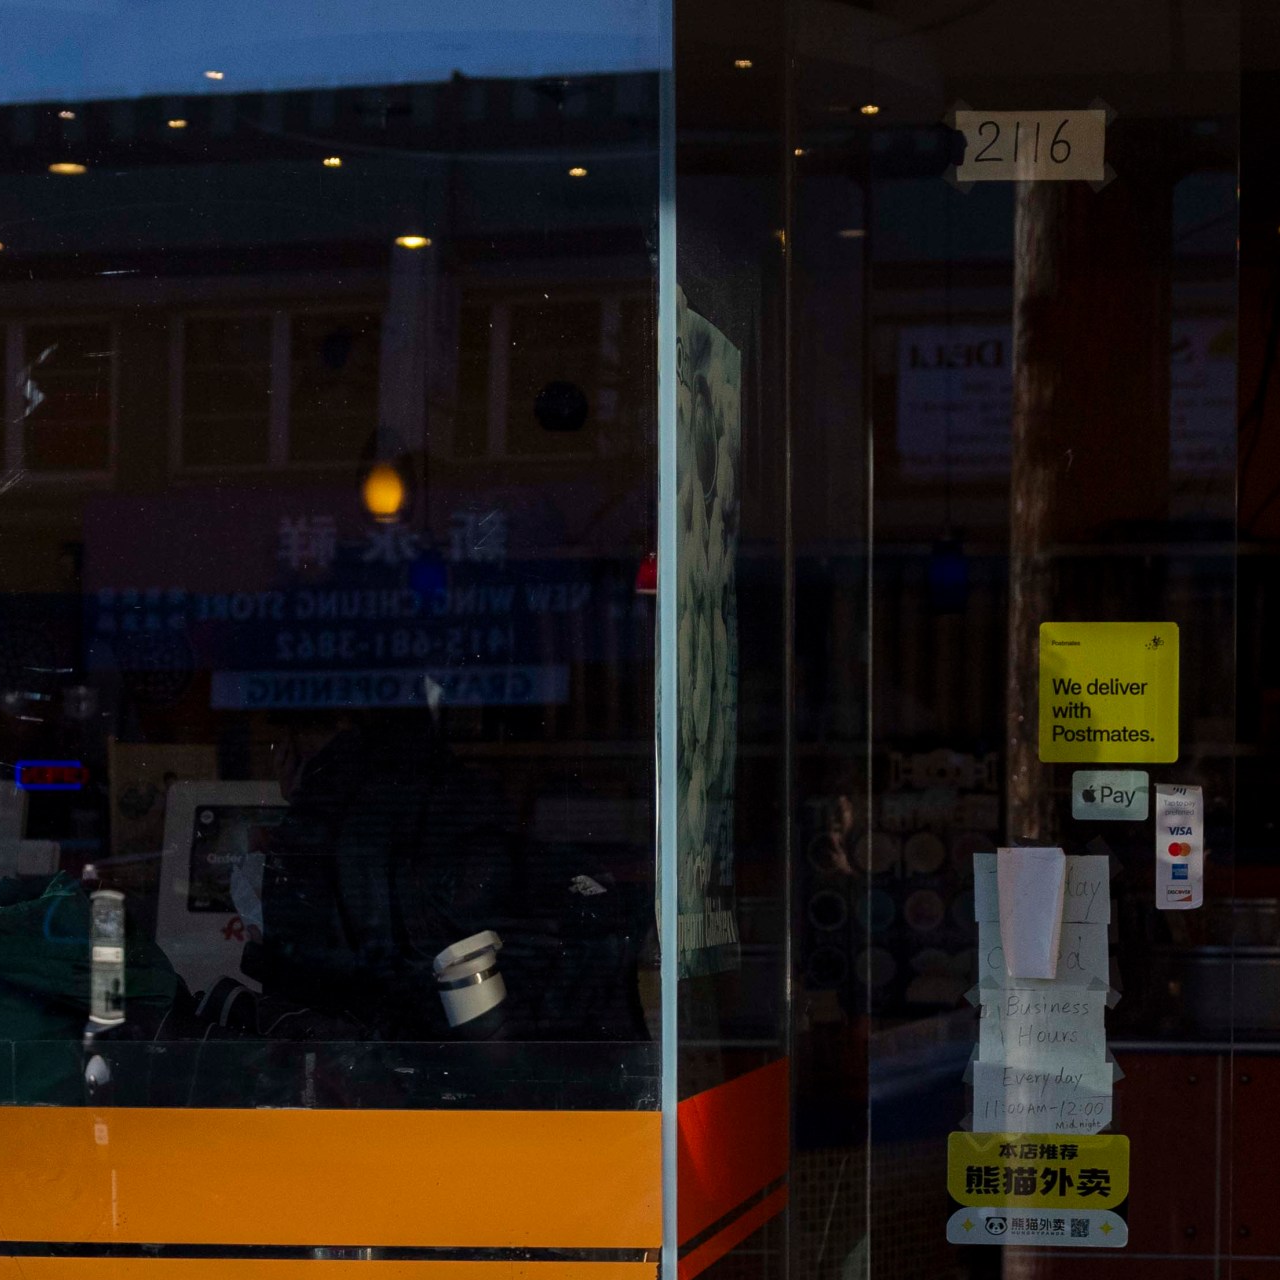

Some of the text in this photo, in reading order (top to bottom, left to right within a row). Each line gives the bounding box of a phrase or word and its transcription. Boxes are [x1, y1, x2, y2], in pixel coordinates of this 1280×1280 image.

[974, 119, 1072, 165] 2116
[1052, 677, 1148, 697] We deliver
[1052, 701, 1091, 719] with
[1052, 725, 1155, 743] Postmates.
[1100, 785, 1136, 808] Pay
[1168, 826, 1193, 836] VISA
[1006, 995, 1091, 1017] Business
[1018, 1024, 1080, 1047] Hours
[999, 1143, 1079, 1161] 本店推荐
[965, 1165, 1111, 1197] 熊猫外卖
[1011, 1217, 1066, 1231] 熊猫外卖
